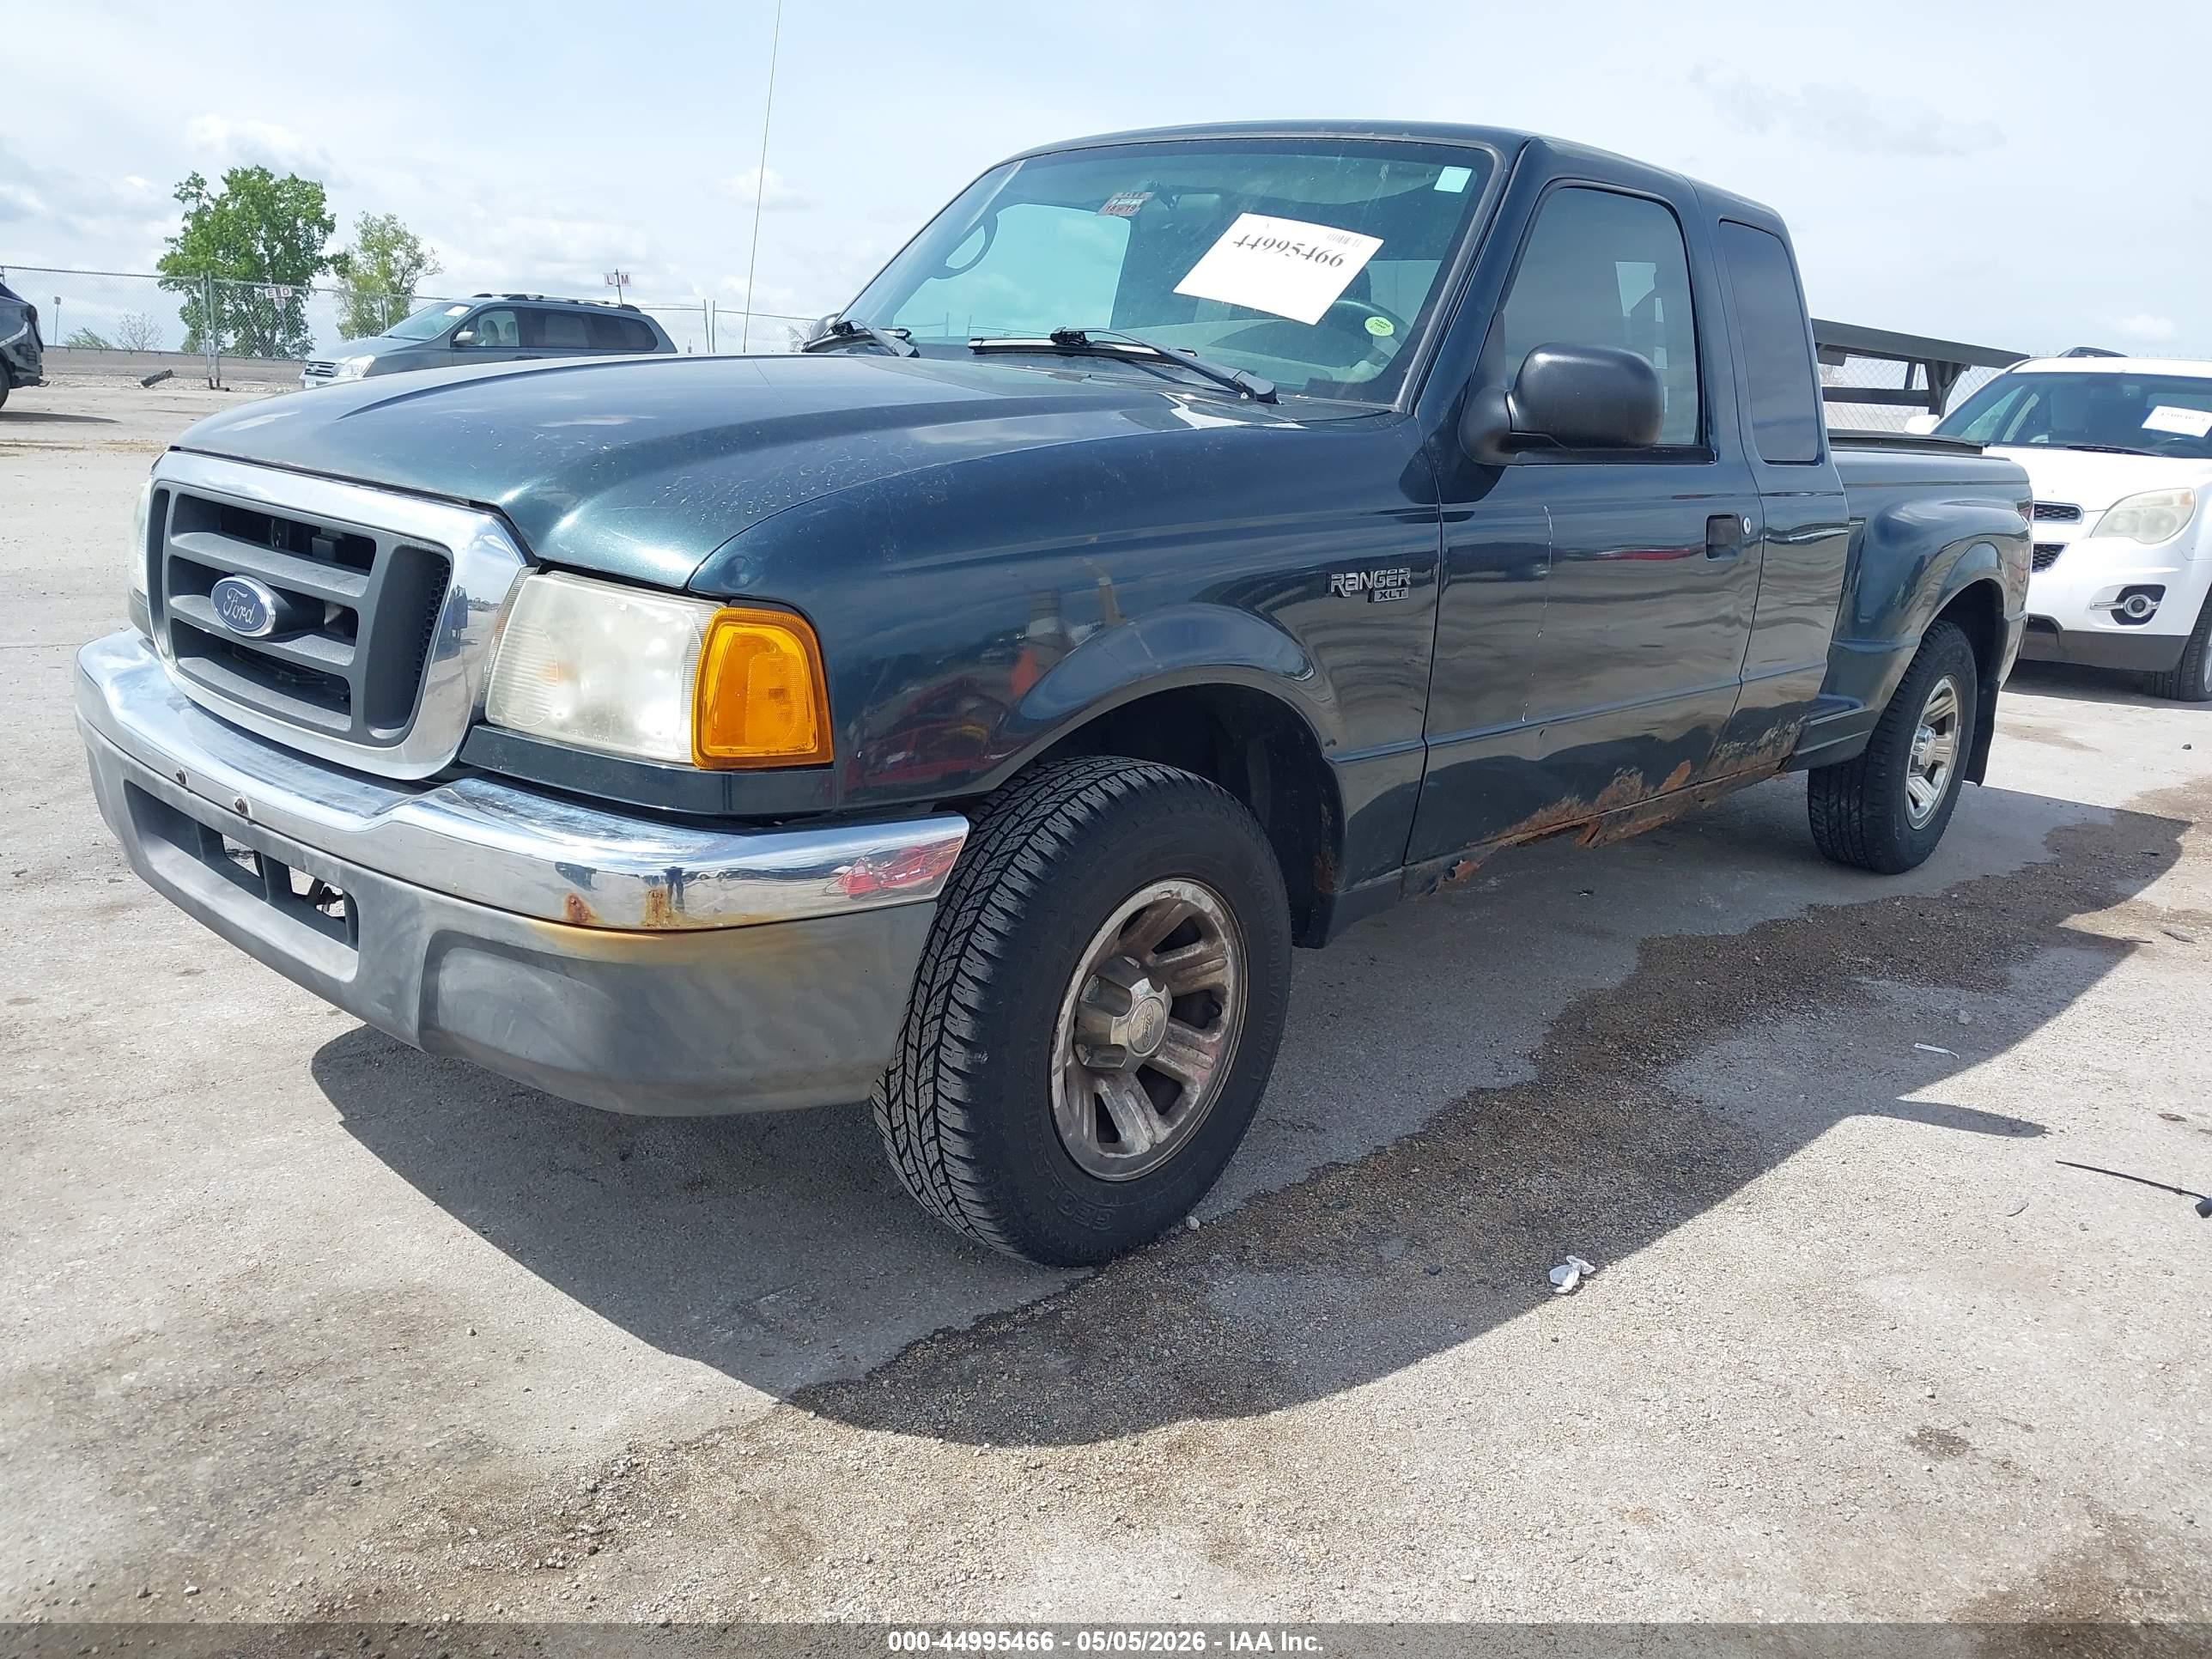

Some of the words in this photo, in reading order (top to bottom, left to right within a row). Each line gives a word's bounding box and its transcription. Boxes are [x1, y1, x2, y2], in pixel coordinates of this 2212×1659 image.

[1232, 234, 1347, 268] 44995466
[606, 274, 613, 285] L
[621, 274, 629, 284] M
[267, 289, 275, 297] E
[283, 288, 289, 296] D
[1330, 567, 1411, 598] RANGER
[1378, 589, 1406, 600] XLT
[222, 586, 257, 625] Ford
